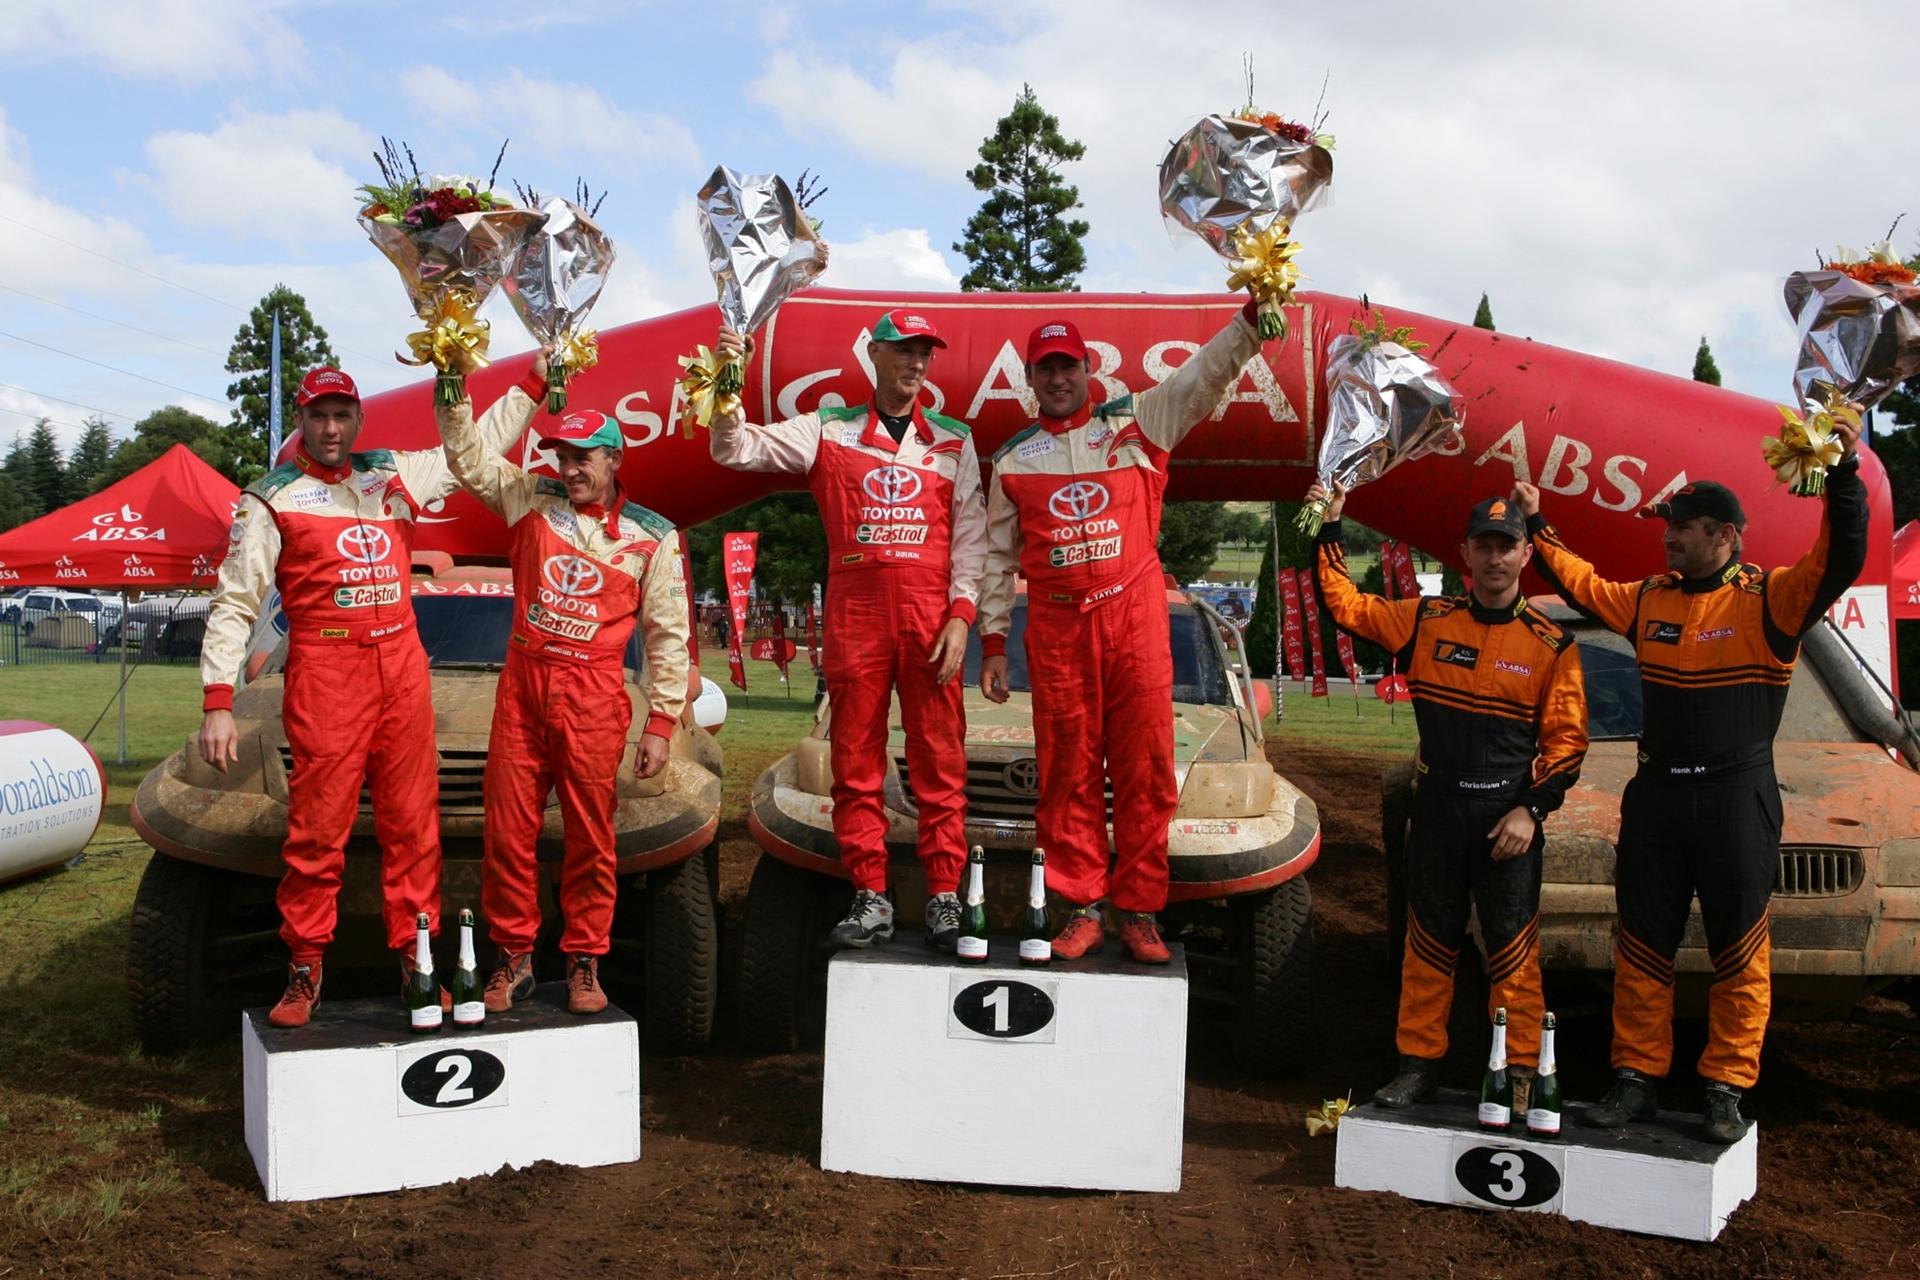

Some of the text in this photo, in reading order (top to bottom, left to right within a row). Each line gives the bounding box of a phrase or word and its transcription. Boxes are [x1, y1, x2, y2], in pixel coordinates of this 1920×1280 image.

[1041, 331, 1068, 339] TOYOTA
[315, 377, 344, 385] TOYOTA
[1019, 438, 1050, 452] IMPERIAL
[1022, 446, 1050, 457] TOYOTA
[296, 497, 328, 508] TOYOTA
[862, 507, 925, 521] TOYOTA
[72, 527, 166, 542] ABSA
[872, 526, 924, 542] Castrol
[1051, 519, 1119, 541] TOYOTA
[1066, 539, 1118, 563] Castrol
[0, 569, 19, 579] BSA
[56, 568, 87, 578] ABSA
[123, 567, 155, 577] ABSA
[339, 564, 399, 583] TOYOTA
[354, 585, 400, 605] Castrol
[537, 586, 599, 618] TOYOTA
[538, 611, 593, 639] Castrol
[1508, 663, 1529, 674] ABSA
[44, 804, 94, 829] SOLUTIONS
[983, 986, 1009, 1031] 1
[435, 1055, 474, 1104] 2
[1488, 1152, 1526, 1200] 3
